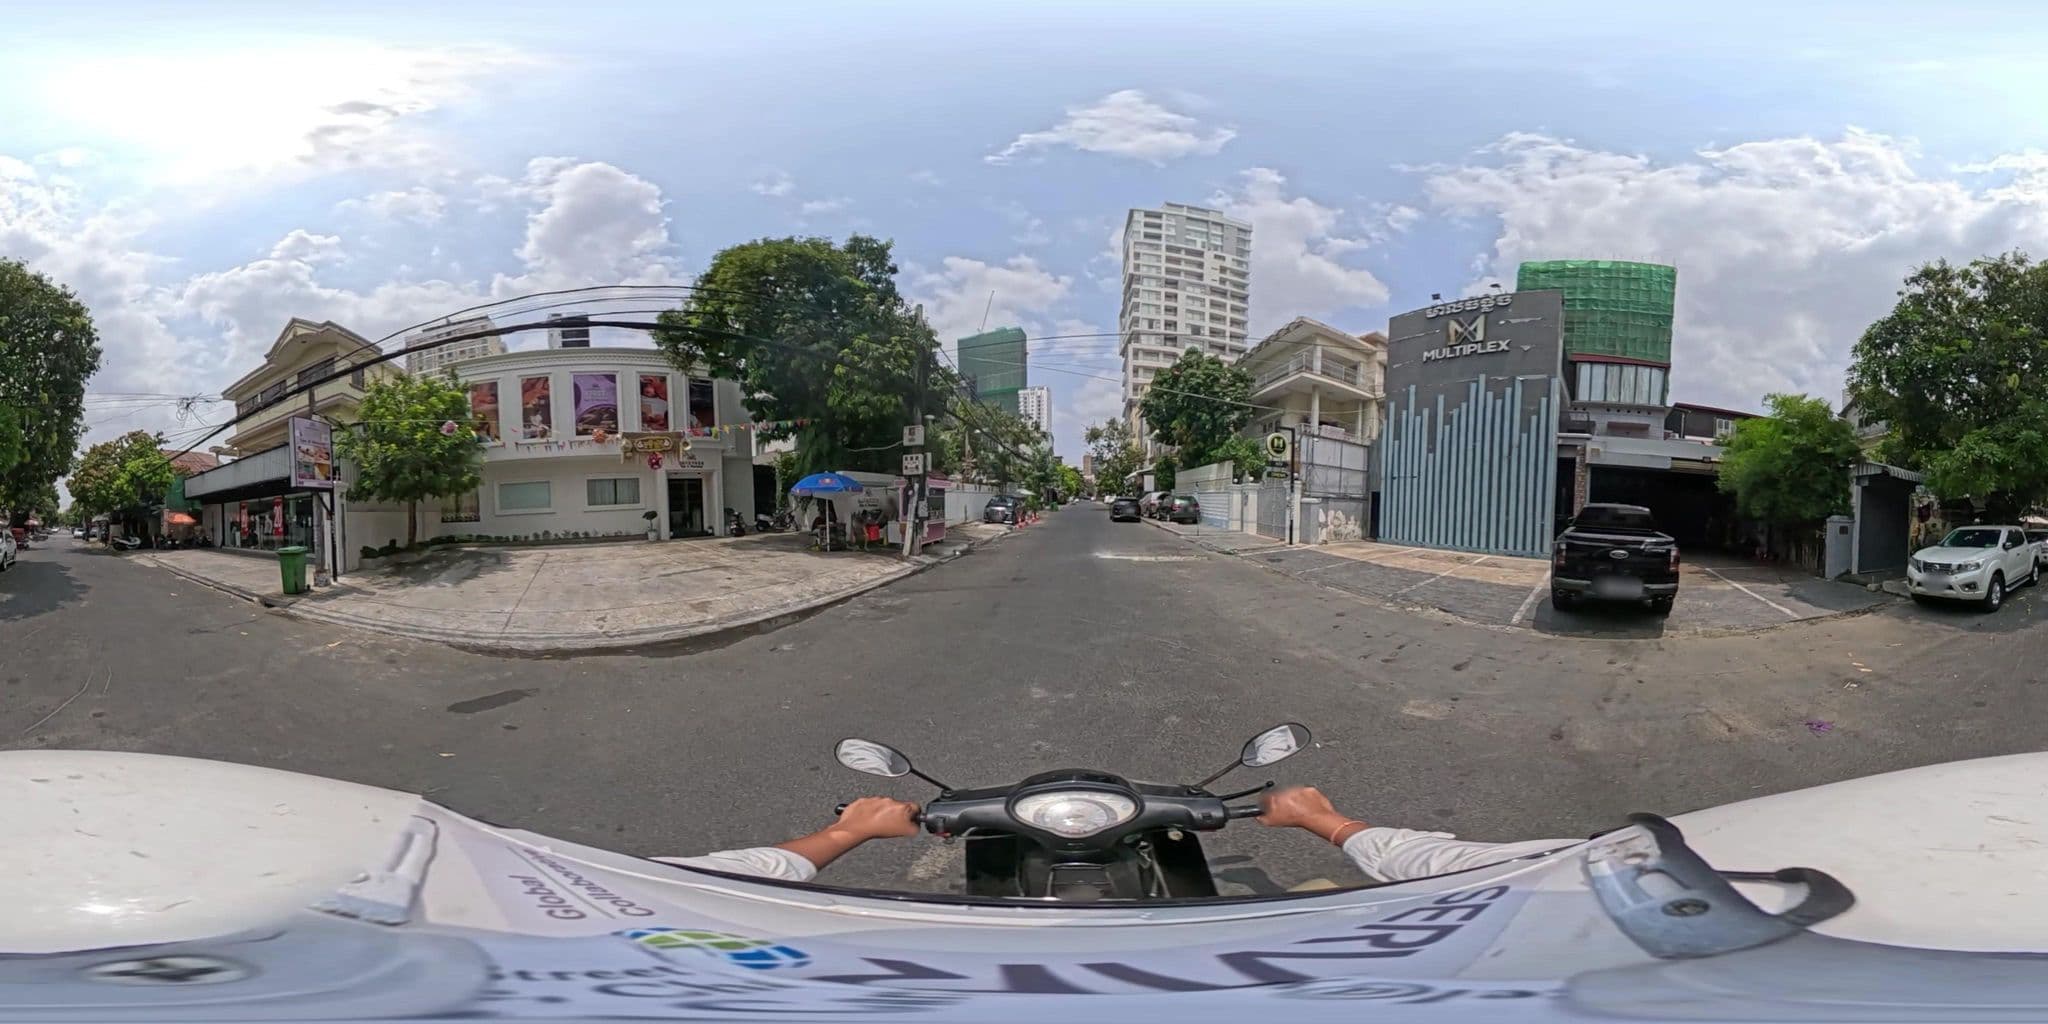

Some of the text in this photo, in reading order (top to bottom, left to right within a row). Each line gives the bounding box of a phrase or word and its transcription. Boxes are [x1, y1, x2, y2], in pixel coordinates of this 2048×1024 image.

[1423, 339, 1512, 362] MULTIPLEX
[509, 875, 587, 920] Global
[523, 848, 656, 917] Collaborative
